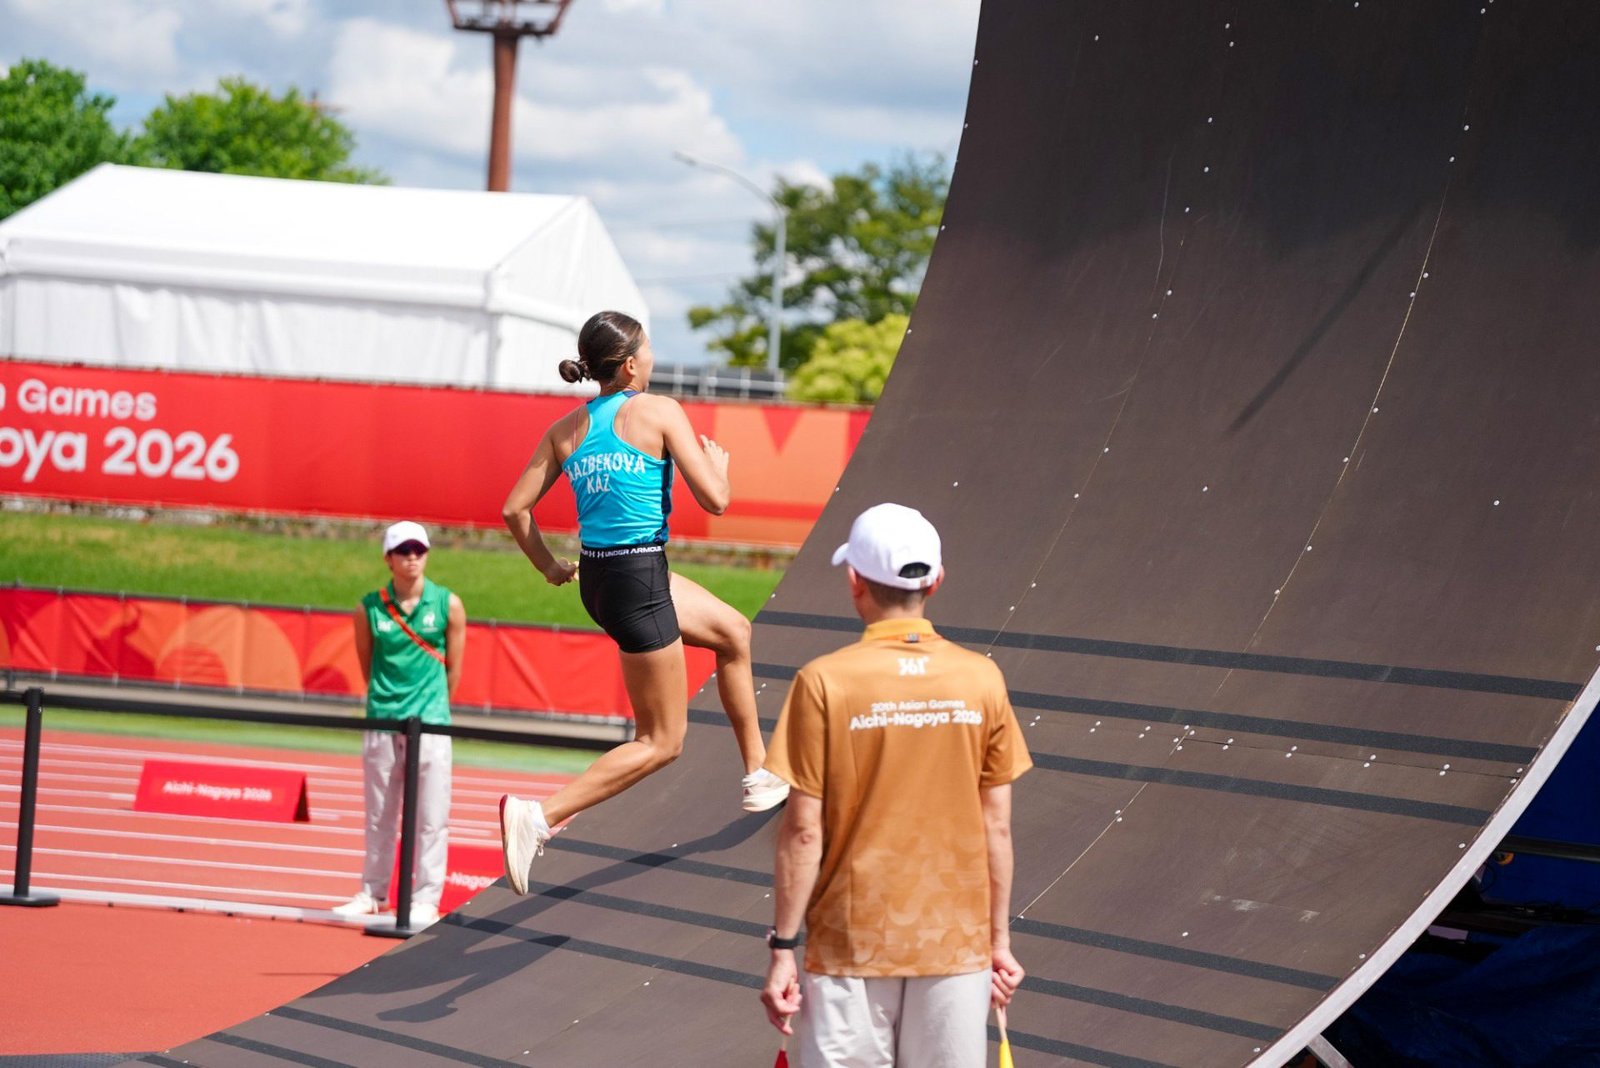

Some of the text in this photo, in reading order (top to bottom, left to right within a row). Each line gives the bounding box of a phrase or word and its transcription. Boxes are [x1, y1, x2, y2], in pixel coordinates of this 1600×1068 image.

[17, 379, 156, 421] Games
[102, 426, 240, 482] 2026
[586, 473, 611, 494] KAZ
[630, 546, 664, 555] ARMOU
[871, 699, 966, 713] 20th Asian Games
[850, 709, 983, 731] Aichi-Nagoya 2026
[162, 780, 241, 801] Aichi-Nagoya
